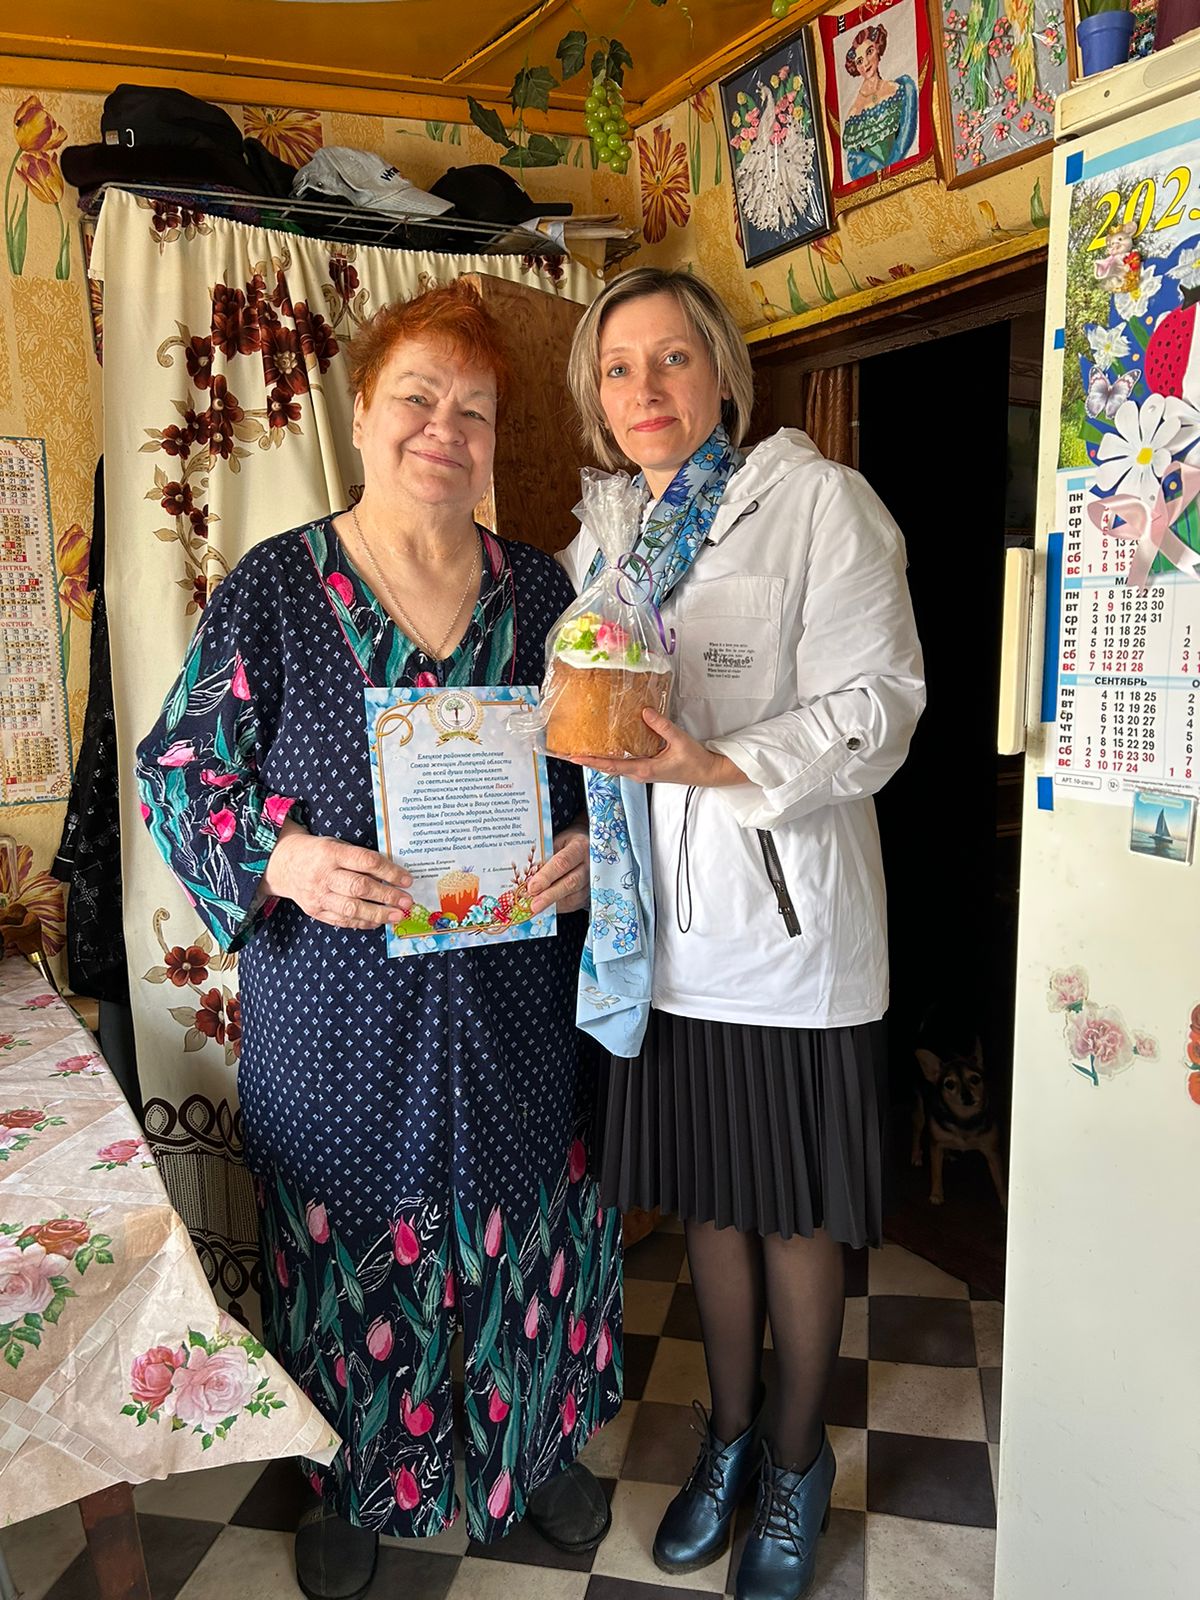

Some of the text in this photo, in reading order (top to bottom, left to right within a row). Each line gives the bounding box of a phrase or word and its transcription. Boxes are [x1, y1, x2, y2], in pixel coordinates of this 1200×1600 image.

[1086, 165, 1200, 253] 202
[1069, 493, 1083, 502] пн
[1069, 505, 1082, 514] вт
[1069, 514, 1109, 528] ср 4
[1069, 530, 1081, 538] чт
[1068, 539, 1126, 551] пт 6 13
[1067, 550, 1125, 562] сб 7 14
[1067, 562, 1126, 575] вс 1 8 15
[1065, 592, 1079, 600] пн
[1094, 591, 1099, 600] 1
[1108, 590, 1114, 599] 8
[1122, 590, 1132, 599] 15
[1152, 588, 1165, 597] 29
[1066, 601, 1164, 612] вт 2 9 16 23 30
[1065, 613, 1162, 625] ср 3 10 17 24 31
[1091, 626, 1097, 635] 4
[1105, 626, 1114, 635] 11
[1120, 626, 1131, 635] 18
[1134, 626, 1146, 635] 25
[1090, 638, 1096, 647] 5
[1104, 638, 1114, 647] 12
[1119, 638, 1129, 647] 19
[1133, 638, 1145, 647] 26
[1063, 649, 1144, 659] сб 6 13 20 27
[1062, 662, 1143, 672] вс 7 14 21 28
[1095, 677, 1147, 686] СЕНТЯБРЬ
[1061, 688, 1156, 701] пн 4 11 18 25
[1061, 700, 1156, 714] вт 5 12 19 26
[1060, 711, 1155, 726] ср 6 13 20 27
[1060, 723, 1155, 738] чт 7 14 21 28
[1059, 735, 1155, 751] пт 1 8 15 22 29
[1059, 745, 1155, 762] сб 2 9 16 23 30
[1058, 759, 1138, 773] вс 3 10 17 24
